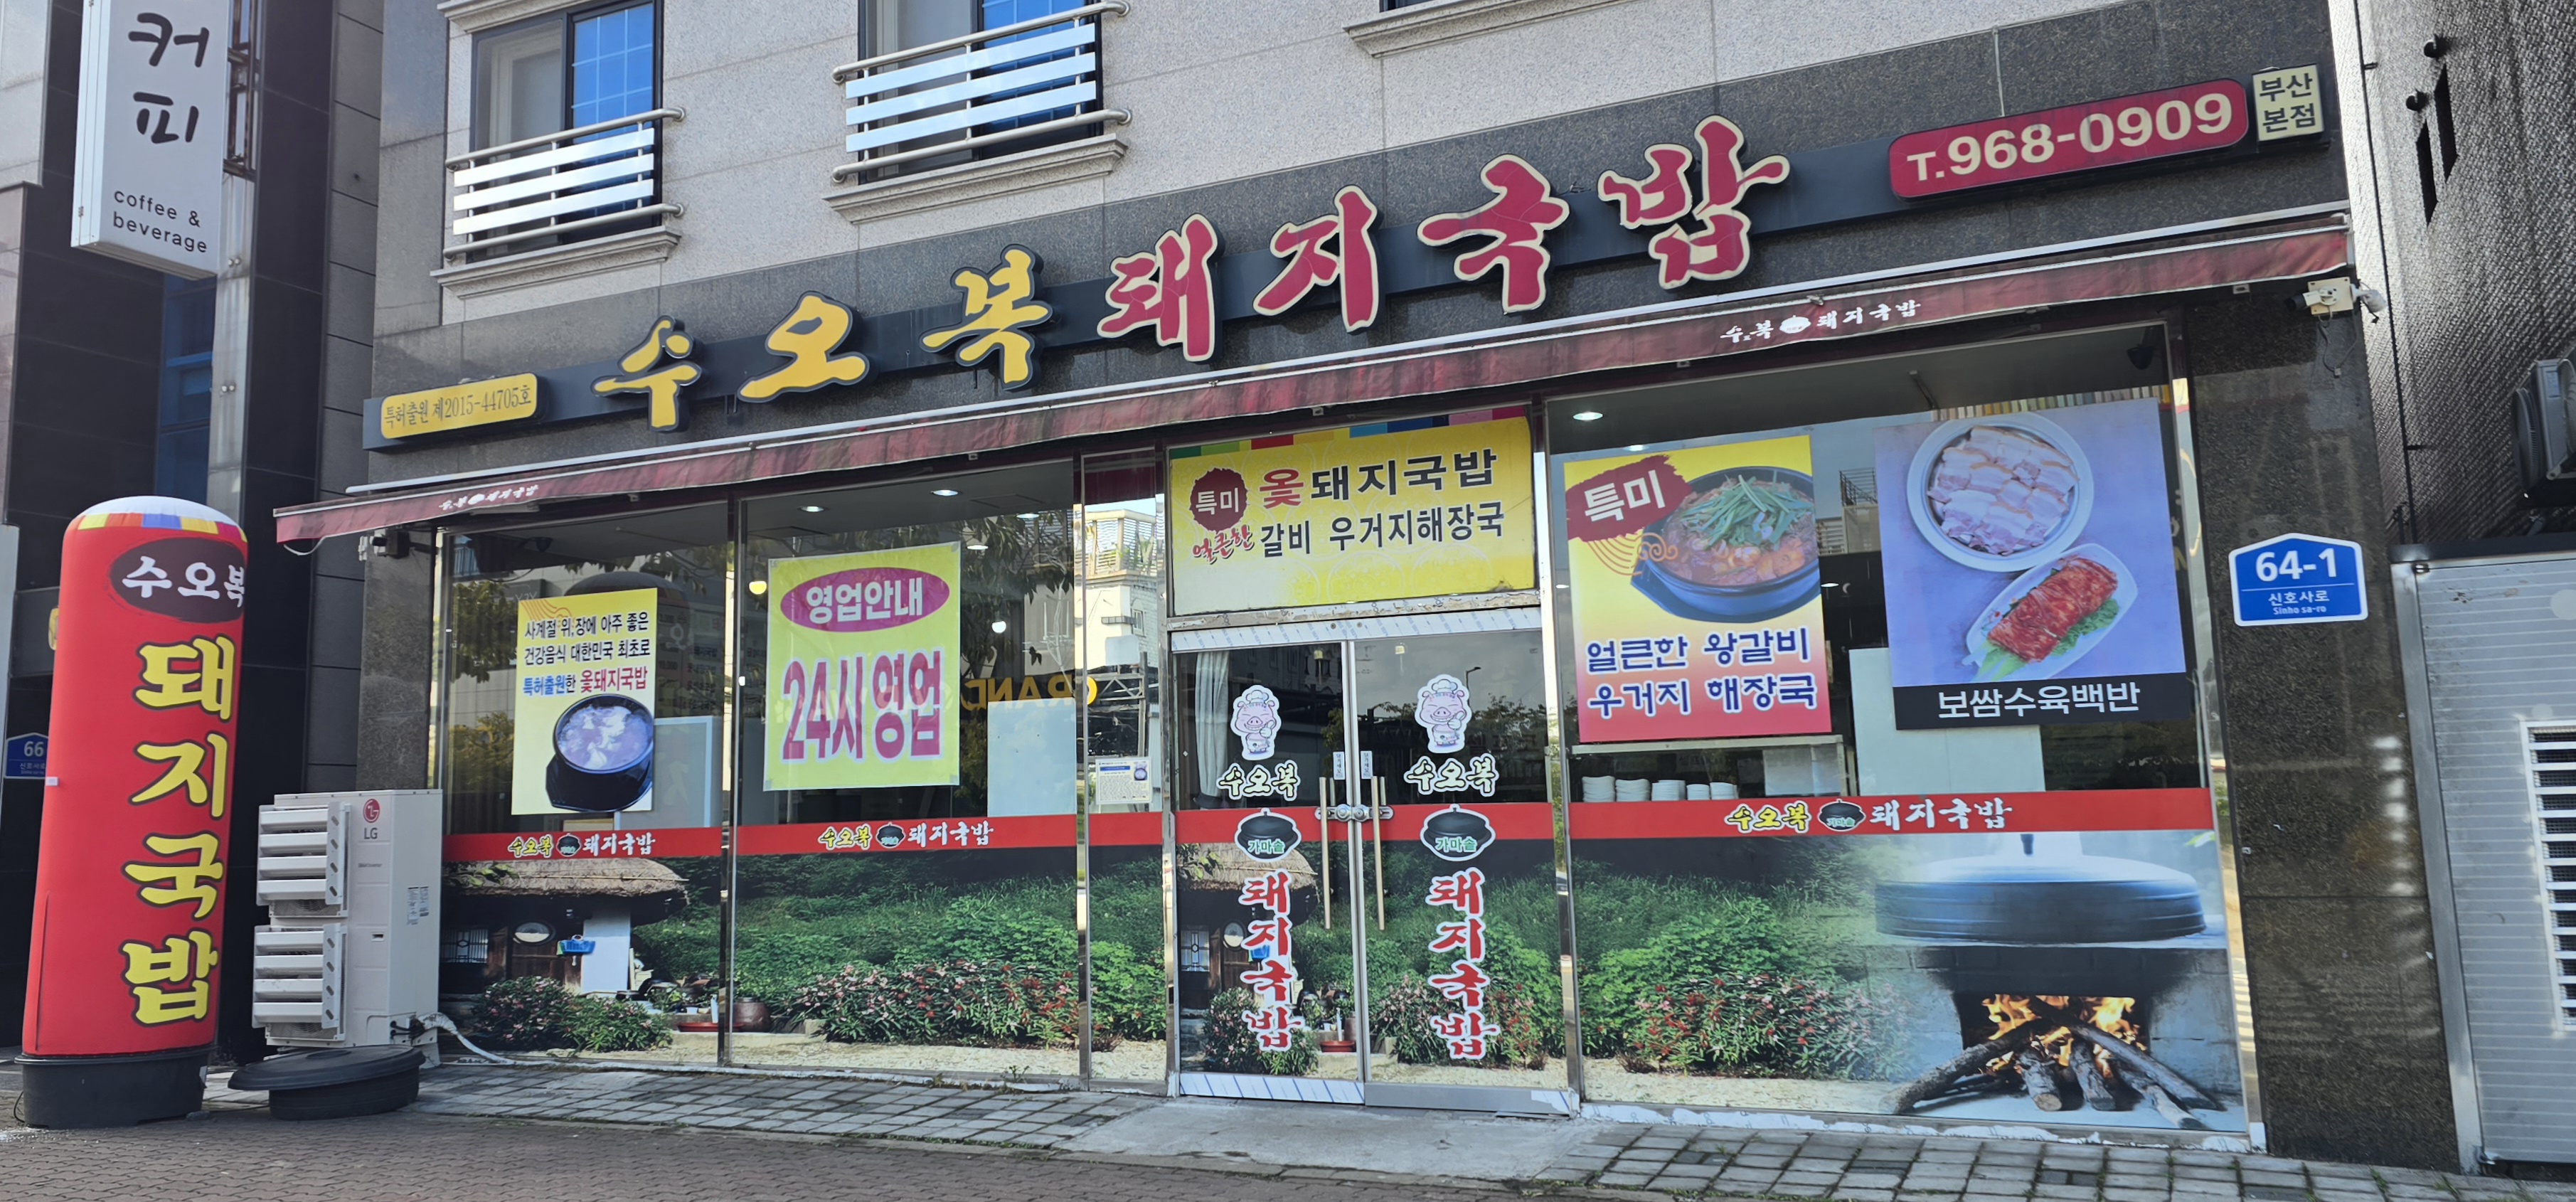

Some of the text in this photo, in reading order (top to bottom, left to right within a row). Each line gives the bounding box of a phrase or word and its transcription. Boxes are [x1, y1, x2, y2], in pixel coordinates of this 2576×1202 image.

[128, 13, 210, 144] 커피
[2260, 73, 2313, 102] 부산
[2262, 102, 2316, 133] 본점
[1908, 92, 2232, 183] T.968-0909
[114, 191, 201, 228] coffee &
[113, 211, 207, 252] beverage
[593, 115, 1790, 431] 수오복 돼지국밥
[1816, 299, 1921, 329] 돼지국밥
[384, 385, 532, 429] 특허출원 제2015-44705호
[1196, 449, 1497, 514] 특미 옻돼지국밥
[1585, 470, 1666, 522] 특미
[1193, 501, 1505, 564] 얼큰한 갈비 우거지해장국
[122, 555, 245, 608] 수오복
[2256, 548, 2336, 582] 64-1
[806, 578, 923, 624] 영업안내
[2268, 590, 2330, 606] 신호사로
[525, 620, 556, 639] 사계절
[601, 615, 622, 633] 아주
[627, 612, 649, 632] 좋은
[524, 639, 650, 665] 건강음식 대한민국 최초로
[1587, 627, 1809, 672] 얼큰한 왕갈비
[523, 666, 648, 696] 특허출원한 옻돼지국밥
[1590, 675, 1815, 717] 우거지 해장국
[1939, 682, 2141, 718] 보쌈수육백반
[782, 649, 943, 762] 24시 영업
[24, 741, 44, 757] 66
[1218, 762, 1299, 799] 수오복
[1407, 756, 1496, 794] 수오복
[123, 637, 235, 1026] 돼지국밥
[364, 827, 378, 839] LG
[1726, 802, 1811, 833] 수오복
[1870, 797, 2012, 831] 돼지국밥
[509, 832, 655, 858] 수오복 돼지국밥
[819, 820, 994, 850] 수오복 돼지국밥
[1240, 869, 1304, 1051] 돼지국밥
[1429, 868, 1497, 1058] 돼지국밥
